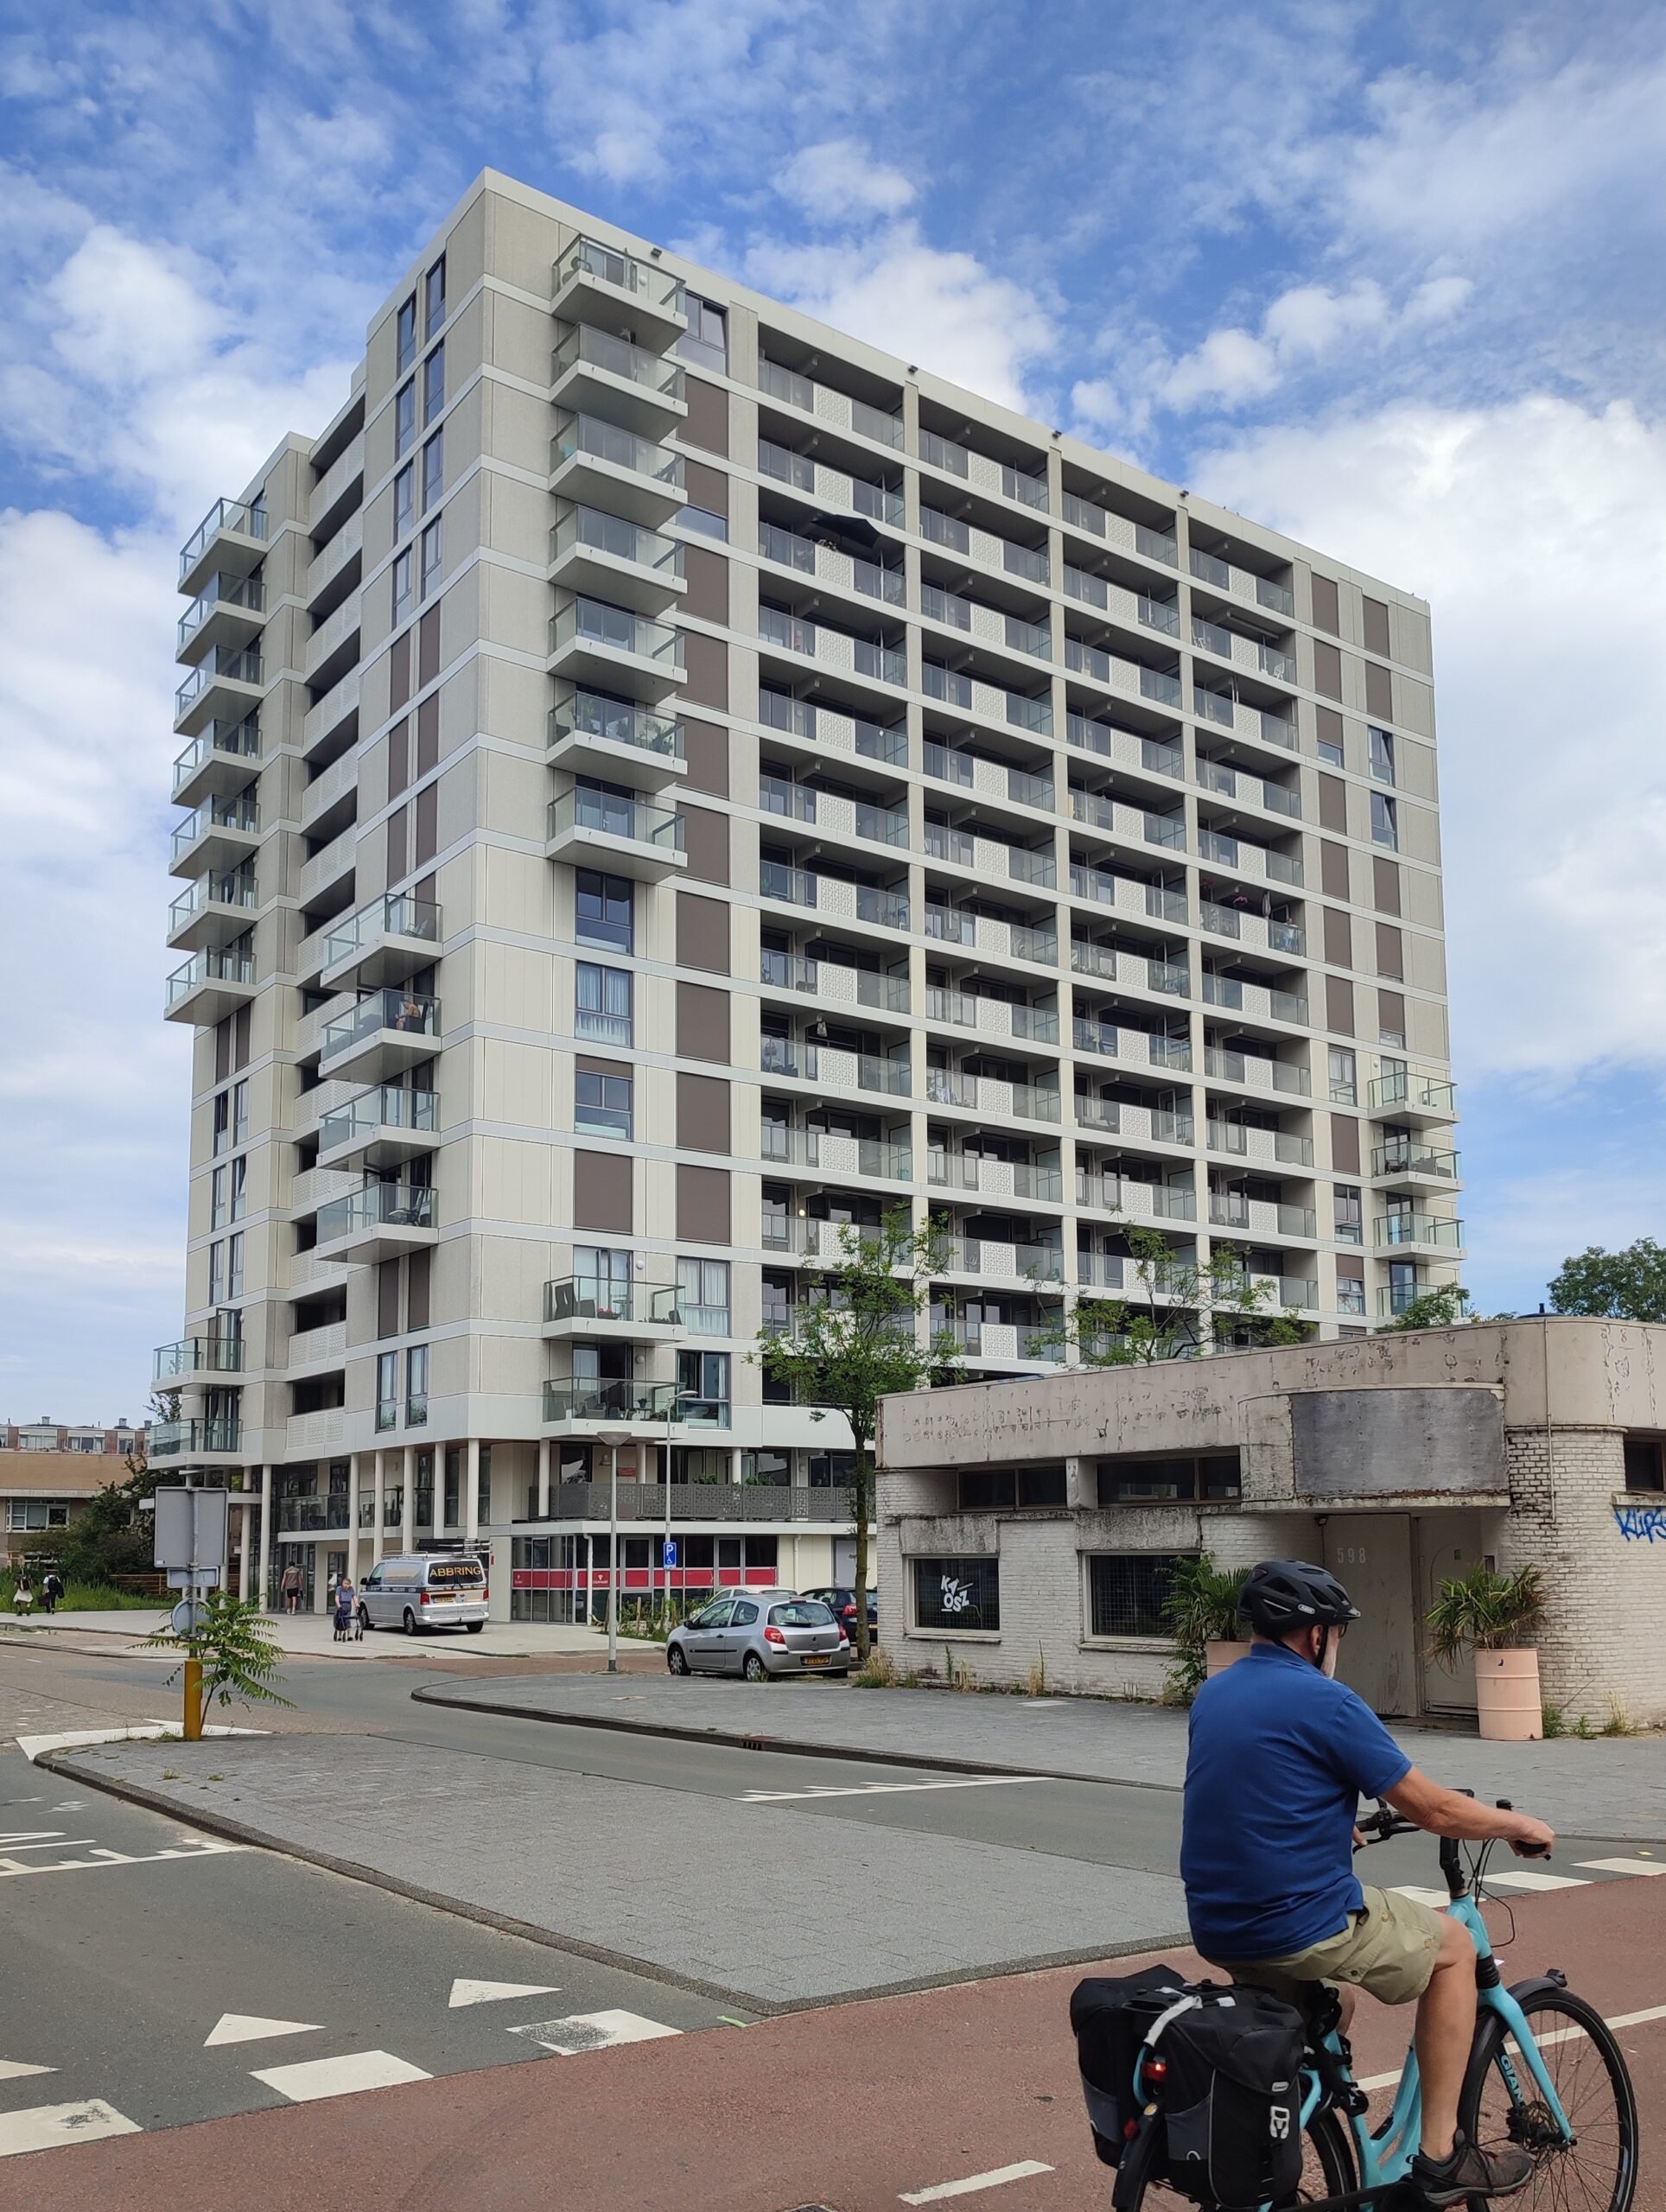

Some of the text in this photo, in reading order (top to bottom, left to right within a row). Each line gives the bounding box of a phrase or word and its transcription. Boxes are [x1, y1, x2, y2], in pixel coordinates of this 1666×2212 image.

[665, 1544, 674, 1556] P
[1337, 1547, 1366, 1564] 598
[429, 1566, 482, 1578] ABBRING
[1500, 2054, 1525, 2105] GIAN
